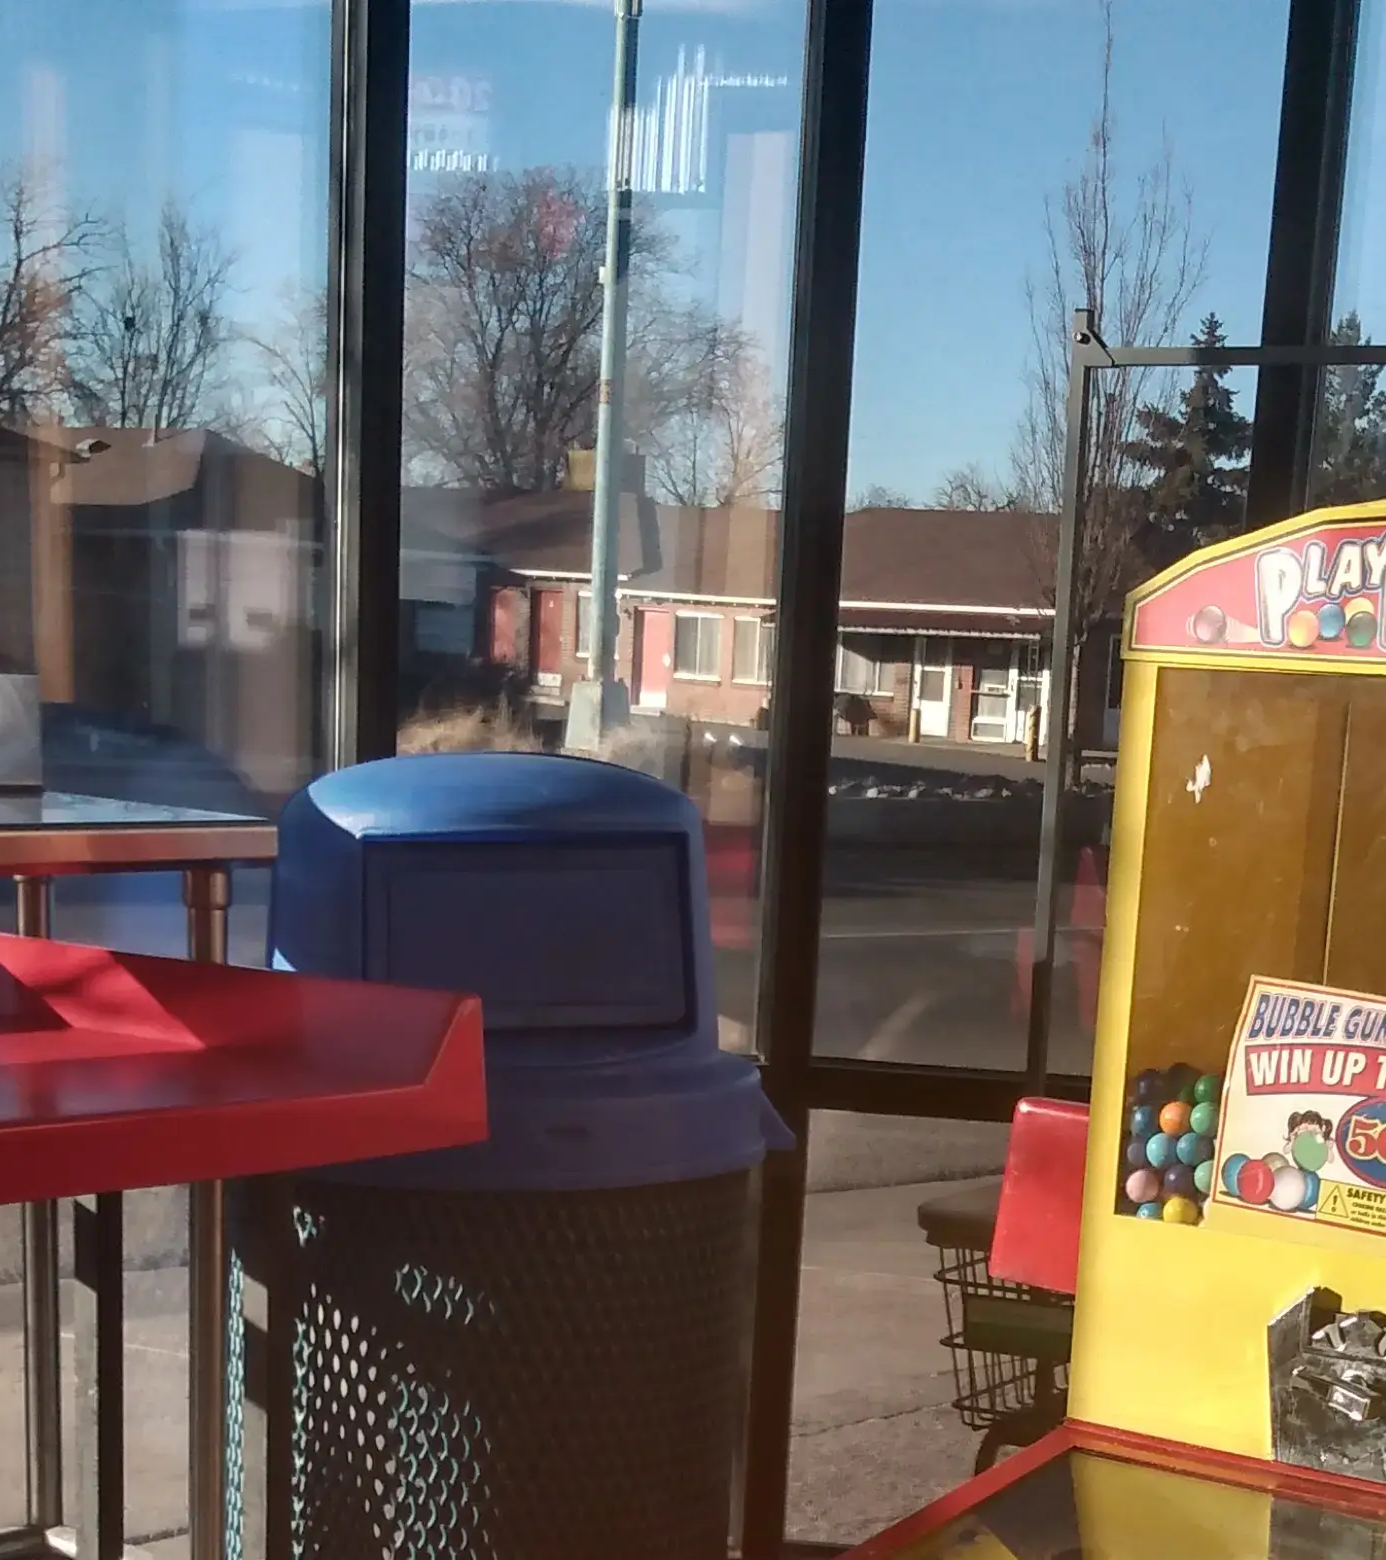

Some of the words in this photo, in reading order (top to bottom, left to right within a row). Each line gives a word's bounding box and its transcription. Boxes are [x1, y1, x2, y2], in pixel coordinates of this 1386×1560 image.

[1246, 992, 1342, 1040] BUBBLE
[1249, 1049, 1312, 1087] WIN
[1321, 1050, 1366, 1086] UP
[1347, 1188, 1386, 1204] SAFETY
